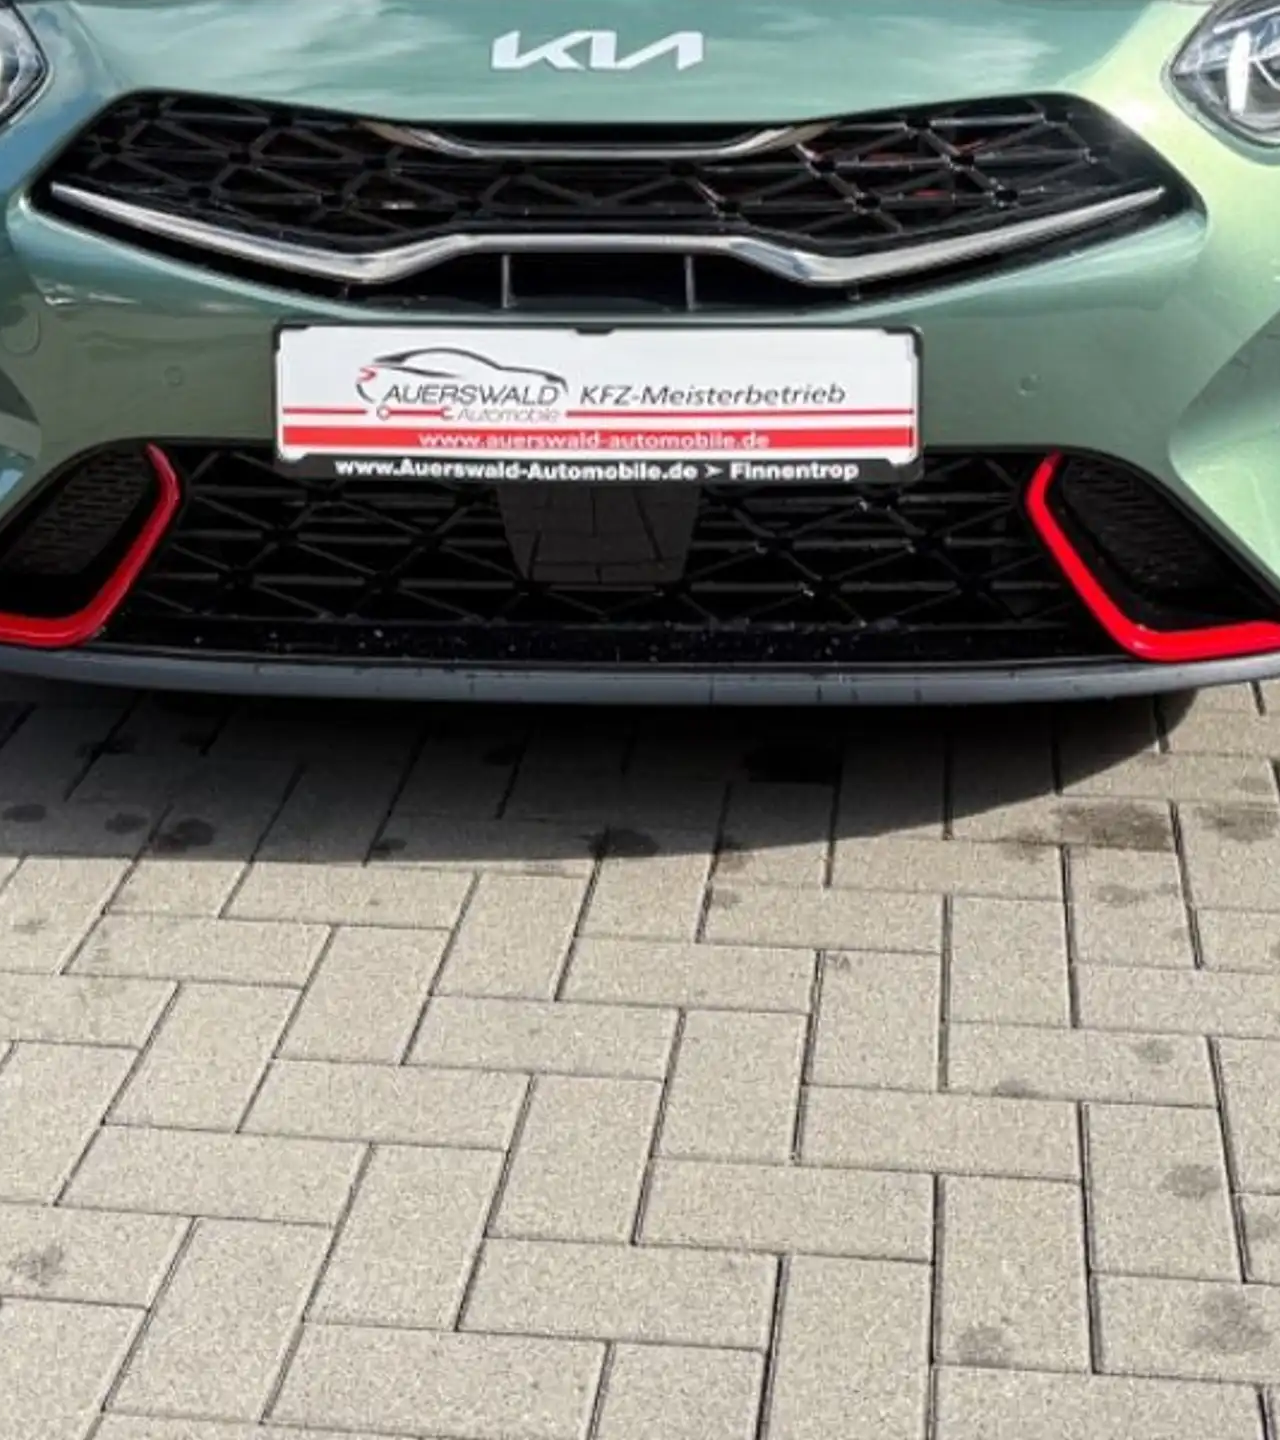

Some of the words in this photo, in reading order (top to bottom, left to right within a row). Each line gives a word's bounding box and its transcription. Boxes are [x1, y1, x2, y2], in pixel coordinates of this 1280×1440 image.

[491, 29, 704, 71] KIA
[382, 383, 559, 405] AUERSWALD
[579, 382, 846, 406] KFZ-Meisterbetrieb
[456, 407, 561, 423] Automobile
[418, 429, 771, 451] www.auerswald-automobile.de
[334, 458, 698, 481] www.Auerswald-Automobile.de
[730, 460, 860, 482] Finnentrop
